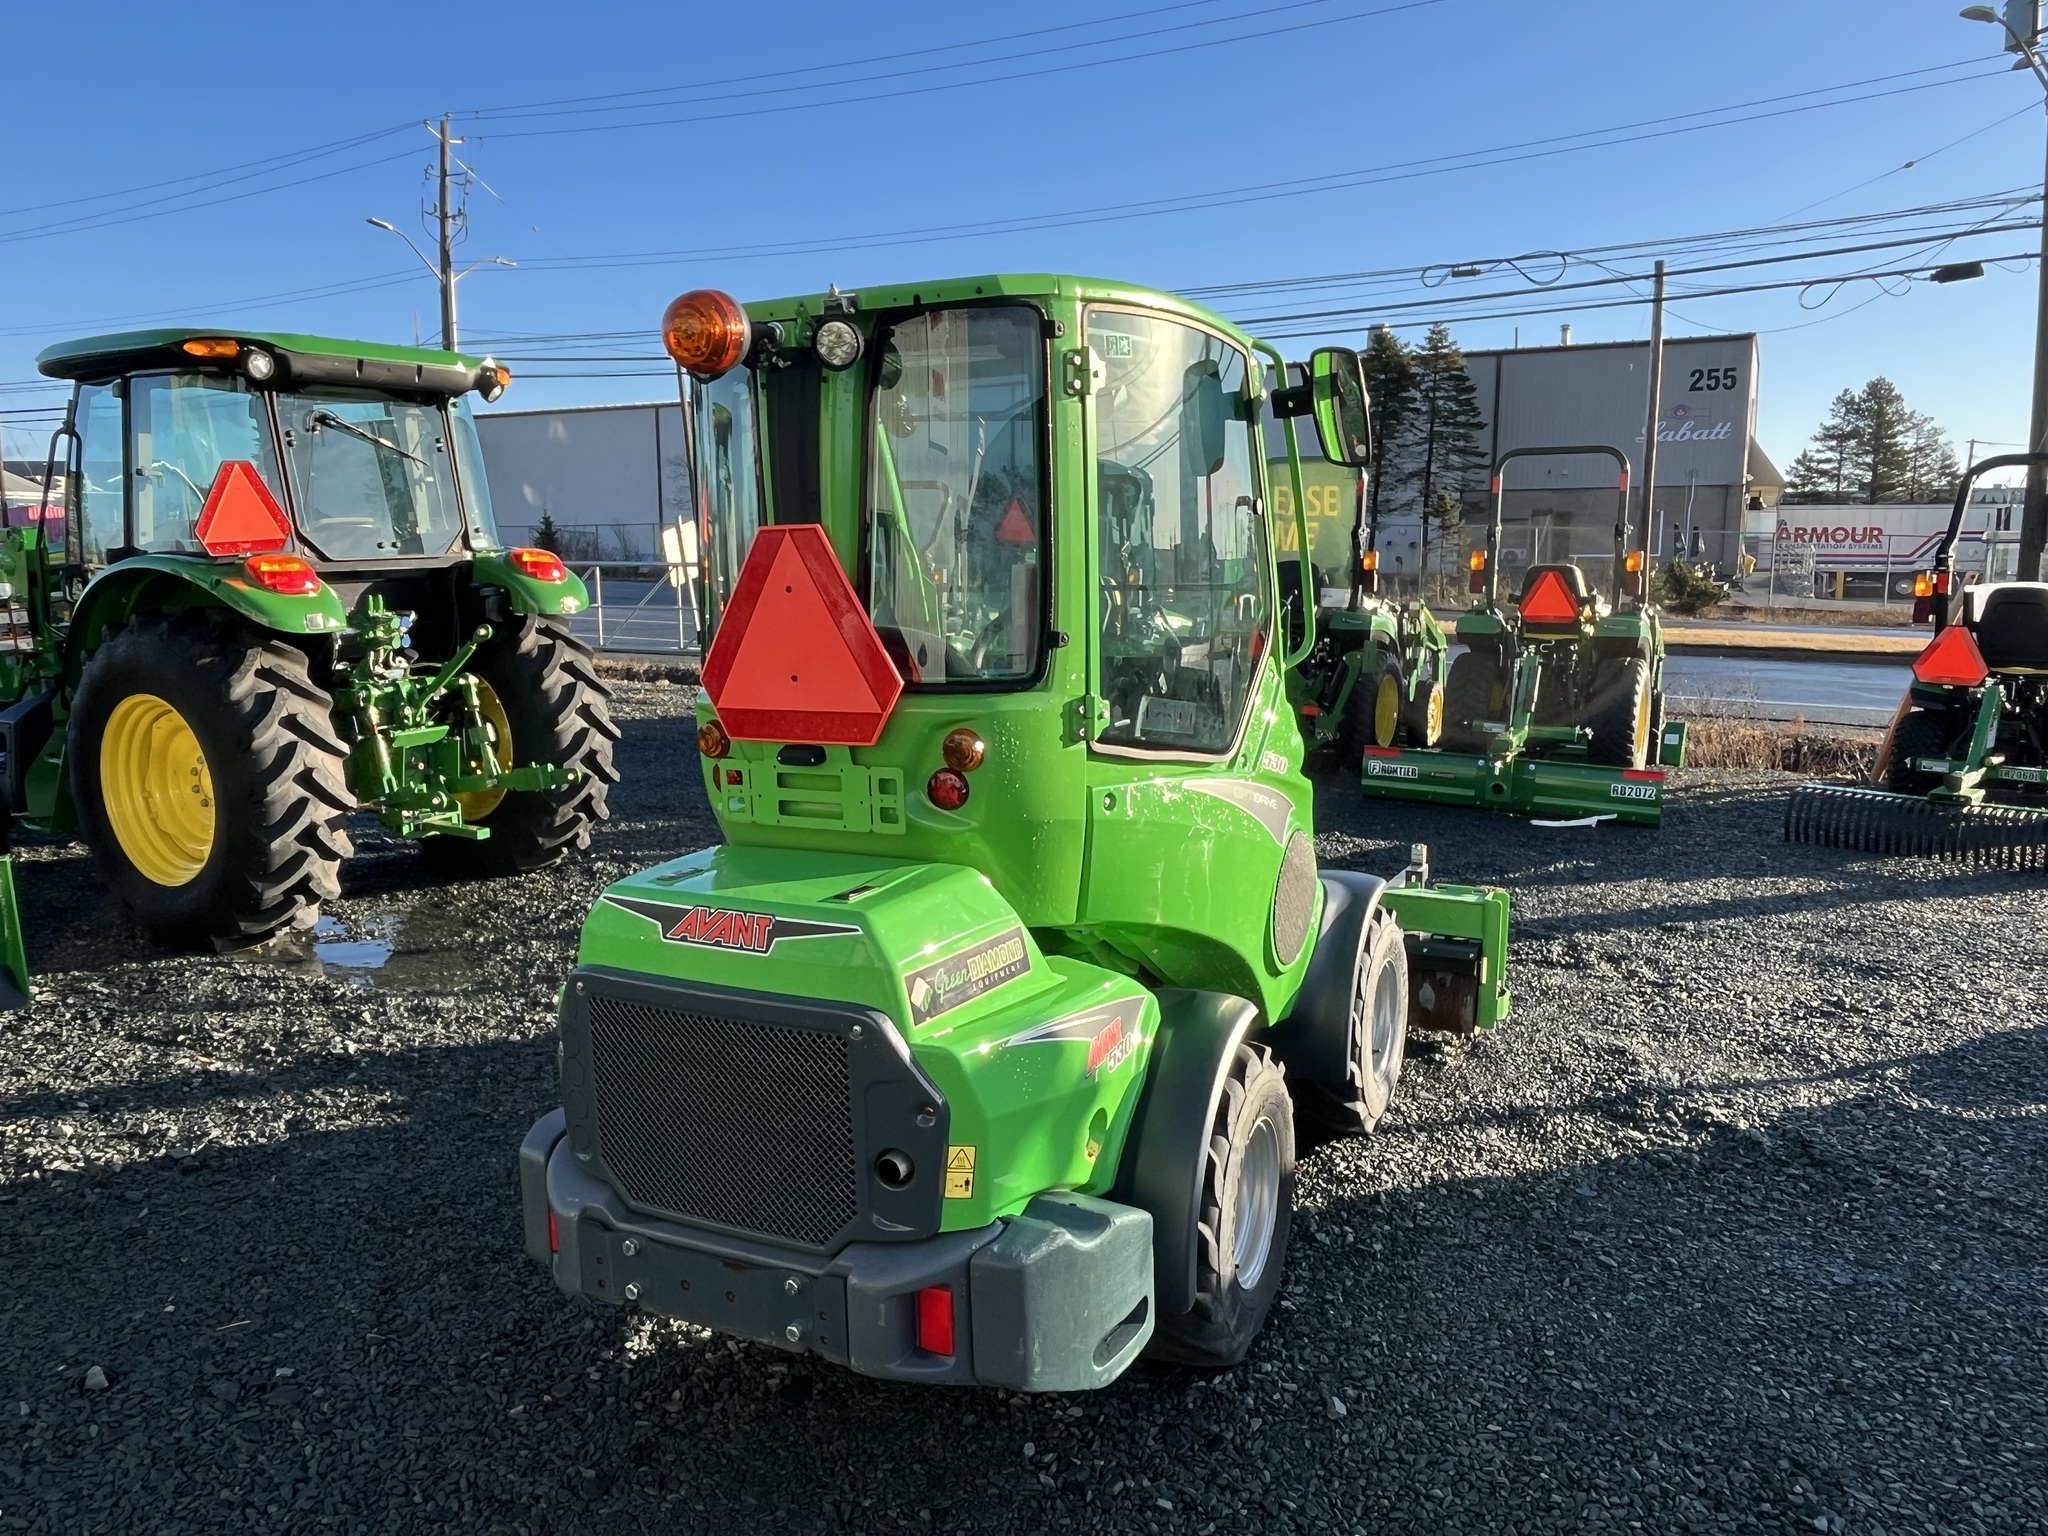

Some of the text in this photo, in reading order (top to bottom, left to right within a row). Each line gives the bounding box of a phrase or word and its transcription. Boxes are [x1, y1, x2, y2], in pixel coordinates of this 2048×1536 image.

[1689, 367, 1737, 392] 255
[1776, 526, 1883, 544] ARMOUR
[1262, 750, 1288, 774] 530
[1368, 760, 1418, 778] FRONTIER
[1611, 784, 1656, 800] RB2072
[666, 907, 774, 951] AVANT
[934, 937, 1024, 1004] Green DIAMOND
[972, 961, 1021, 991] EQUIPMENT
[1107, 1032, 1133, 1073] 530
